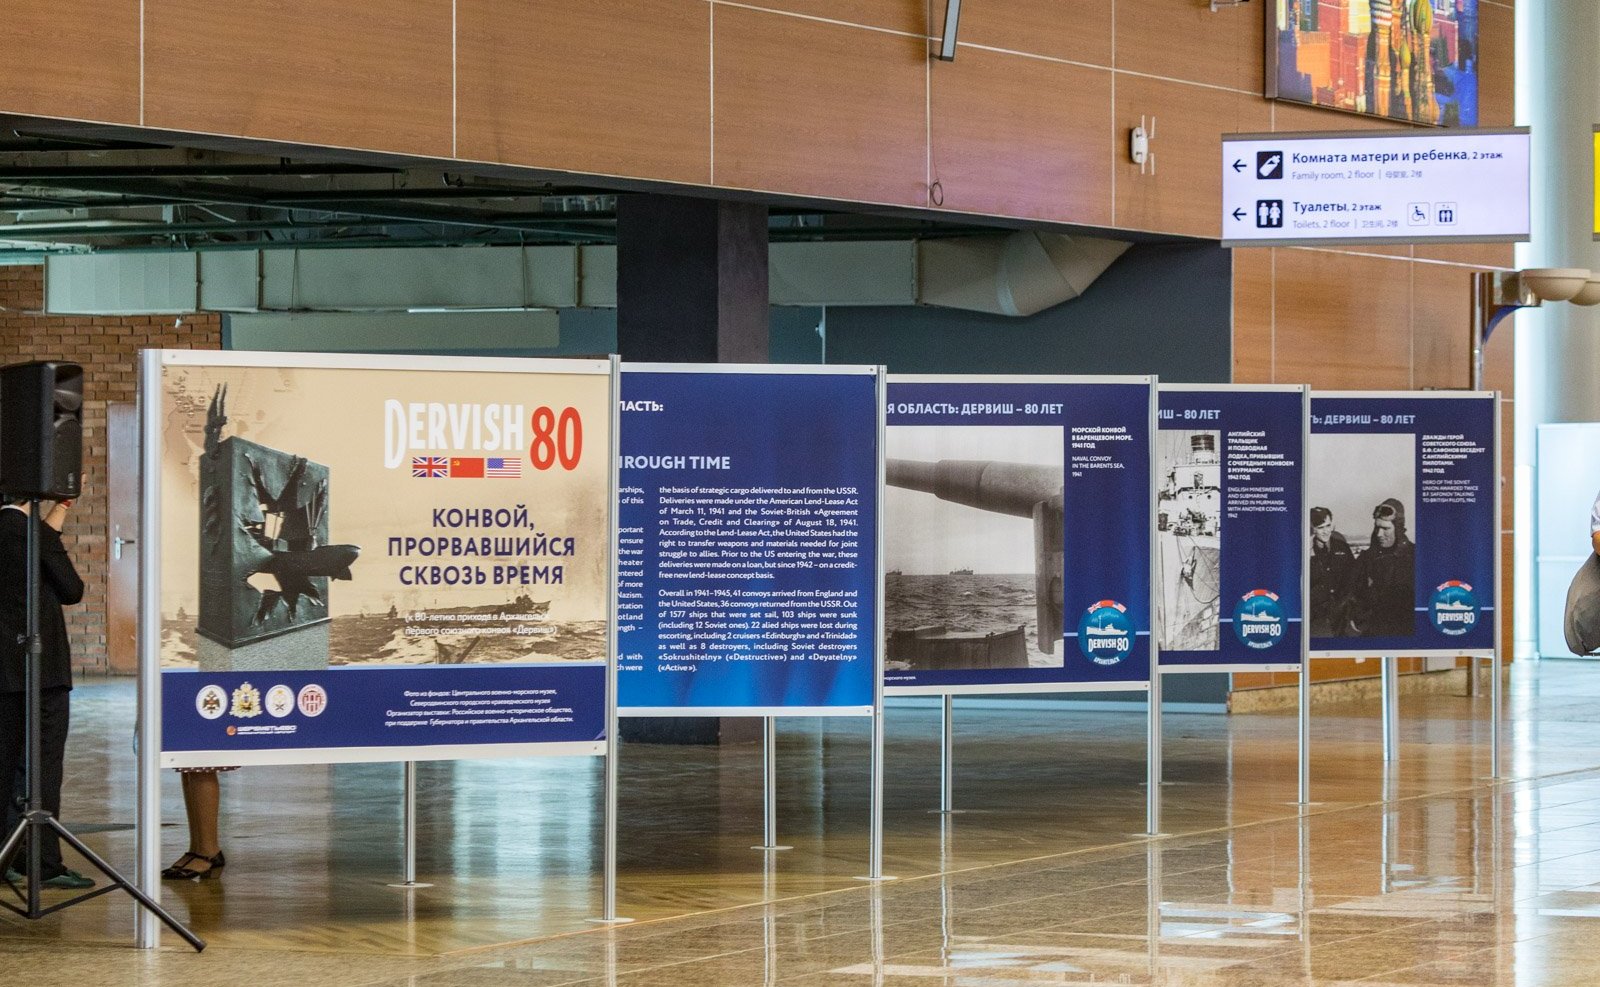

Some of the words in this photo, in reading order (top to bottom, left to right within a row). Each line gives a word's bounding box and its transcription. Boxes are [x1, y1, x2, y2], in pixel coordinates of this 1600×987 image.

[1293, 152, 1347, 163] Комната
[1351, 153, 1398, 164] матери
[1414, 149, 1470, 163] ребенка,
[1292, 171, 1319, 181] Family
[1354, 170, 1374, 179] floor
[1293, 201, 1350, 214] Туалеты,
[1293, 220, 1321, 229] Toilets,
[1323, 220, 1328, 228] 2
[1330, 219, 1350, 228] floor
[887, 404, 894, 414] Я
[898, 404, 959, 414] ОБЛАСТЬ:
[961, 404, 1013, 415] ДЕРВИШ
[1025, 404, 1038, 414] 80
[1040, 404, 1063, 414] ЛЕТ
[1184, 410, 1197, 419] 80
[1199, 410, 1221, 419] ЛЕТ
[1324, 415, 1371, 425] ДЕРВИШ
[1381, 415, 1393, 424] 80
[1395, 415, 1416, 424] ЛЕТ
[384, 399, 524, 469] DERVISH
[530, 406, 582, 470] 80
[688, 456, 730, 469] TIME
[432, 504, 534, 530] КОНВОЙ,
[814, 509, 858, 517] «Agreement
[744, 518, 780, 527] Clearing»
[796, 519, 822, 527] August
[388, 533, 575, 556] ПРОРВАВШИЙСЯ
[399, 566, 486, 585] СКВОЗЬ
[493, 566, 563, 585] ВРЕМЯ
[689, 611, 708, 619] ships
[798, 611, 816, 619] ships
[1437, 612, 1463, 624] DERVISH
[1463, 612, 1474, 624] 80
[405, 627, 438, 636] первого
[1242, 624, 1269, 637] DERVISH
[1270, 623, 1281, 636] 80
[709, 643, 751, 651] destroyers,
[754, 643, 788, 651] including
[818, 643, 858, 651] destroyers
[1088, 638, 1116, 652] DERVISH
[1117, 638, 1129, 651] 80
[658, 653, 722, 662] «Sokrushitelny»
[726, 653, 787, 662] («Destructive»)
[808, 653, 857, 662] «Deyatelny»
